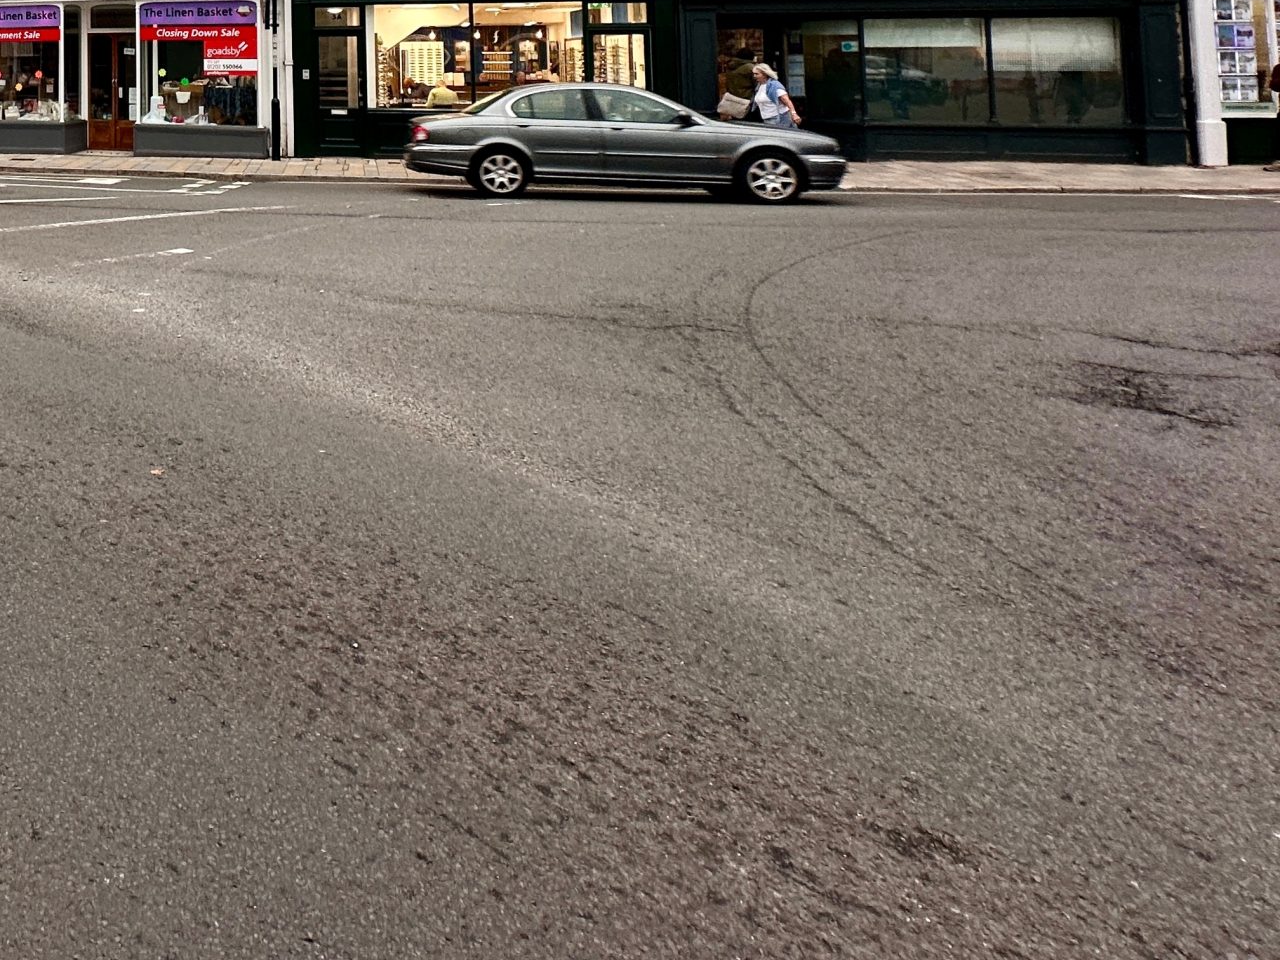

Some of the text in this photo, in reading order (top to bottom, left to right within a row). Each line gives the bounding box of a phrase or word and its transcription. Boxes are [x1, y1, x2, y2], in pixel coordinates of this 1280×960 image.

[0, 11, 23, 20] Linen
[26, 11, 57, 20] Basket
[144, 7, 233, 17] The Linen Basket
[23, 31, 40, 39] Sale
[156, 28, 240, 39] Closing Down Sale
[207, 46, 240, 57] goadsby
